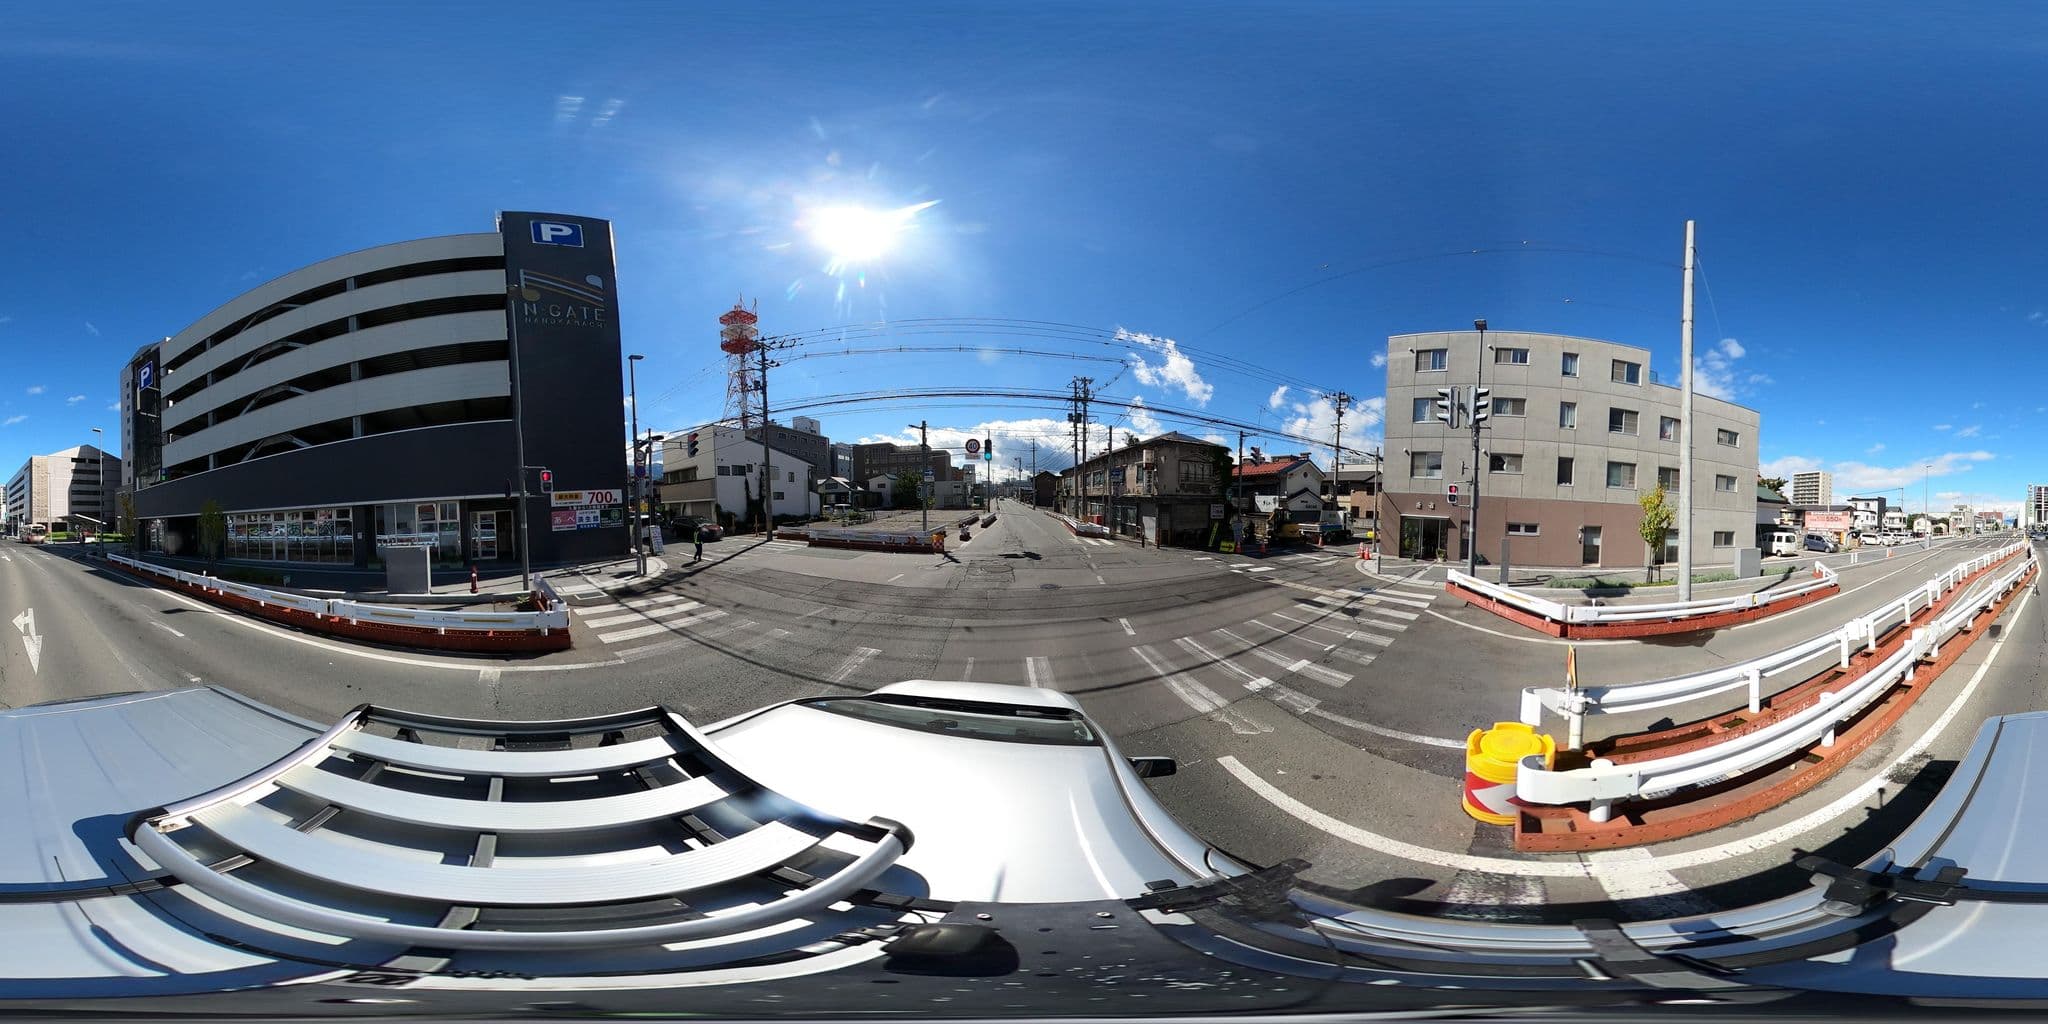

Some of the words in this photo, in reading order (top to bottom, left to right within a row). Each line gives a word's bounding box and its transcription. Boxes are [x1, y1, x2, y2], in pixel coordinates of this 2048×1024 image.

[541, 223, 573, 242] P
[141, 366, 150, 388] P
[969, 442, 977, 450] 40
